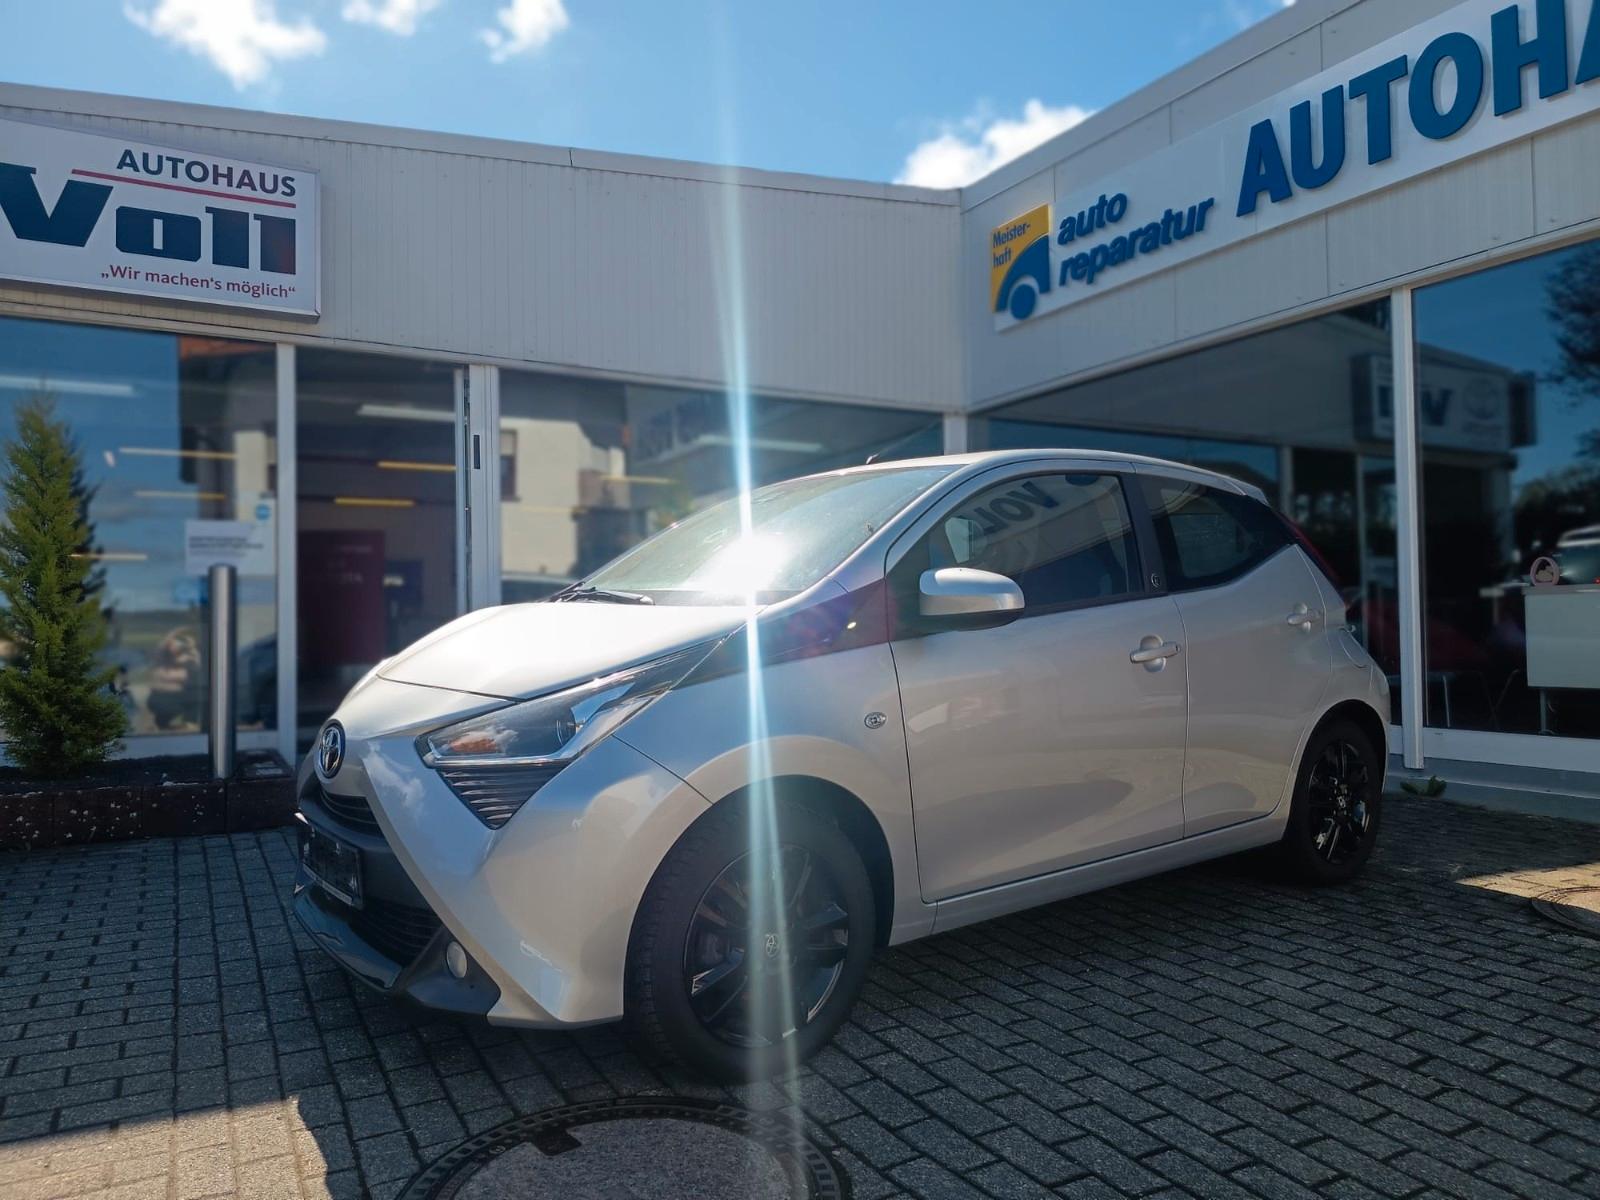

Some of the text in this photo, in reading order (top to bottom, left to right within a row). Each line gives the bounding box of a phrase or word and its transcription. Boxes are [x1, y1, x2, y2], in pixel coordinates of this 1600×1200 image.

[1236, 0, 1600, 218] AUTOH
[116, 149, 297, 198] AUTOHAUS
[992, 222, 1032, 249] Meister-
[1057, 192, 1128, 246] auto
[1058, 196, 1216, 287] reparatur
[992, 246, 1012, 269] haft
